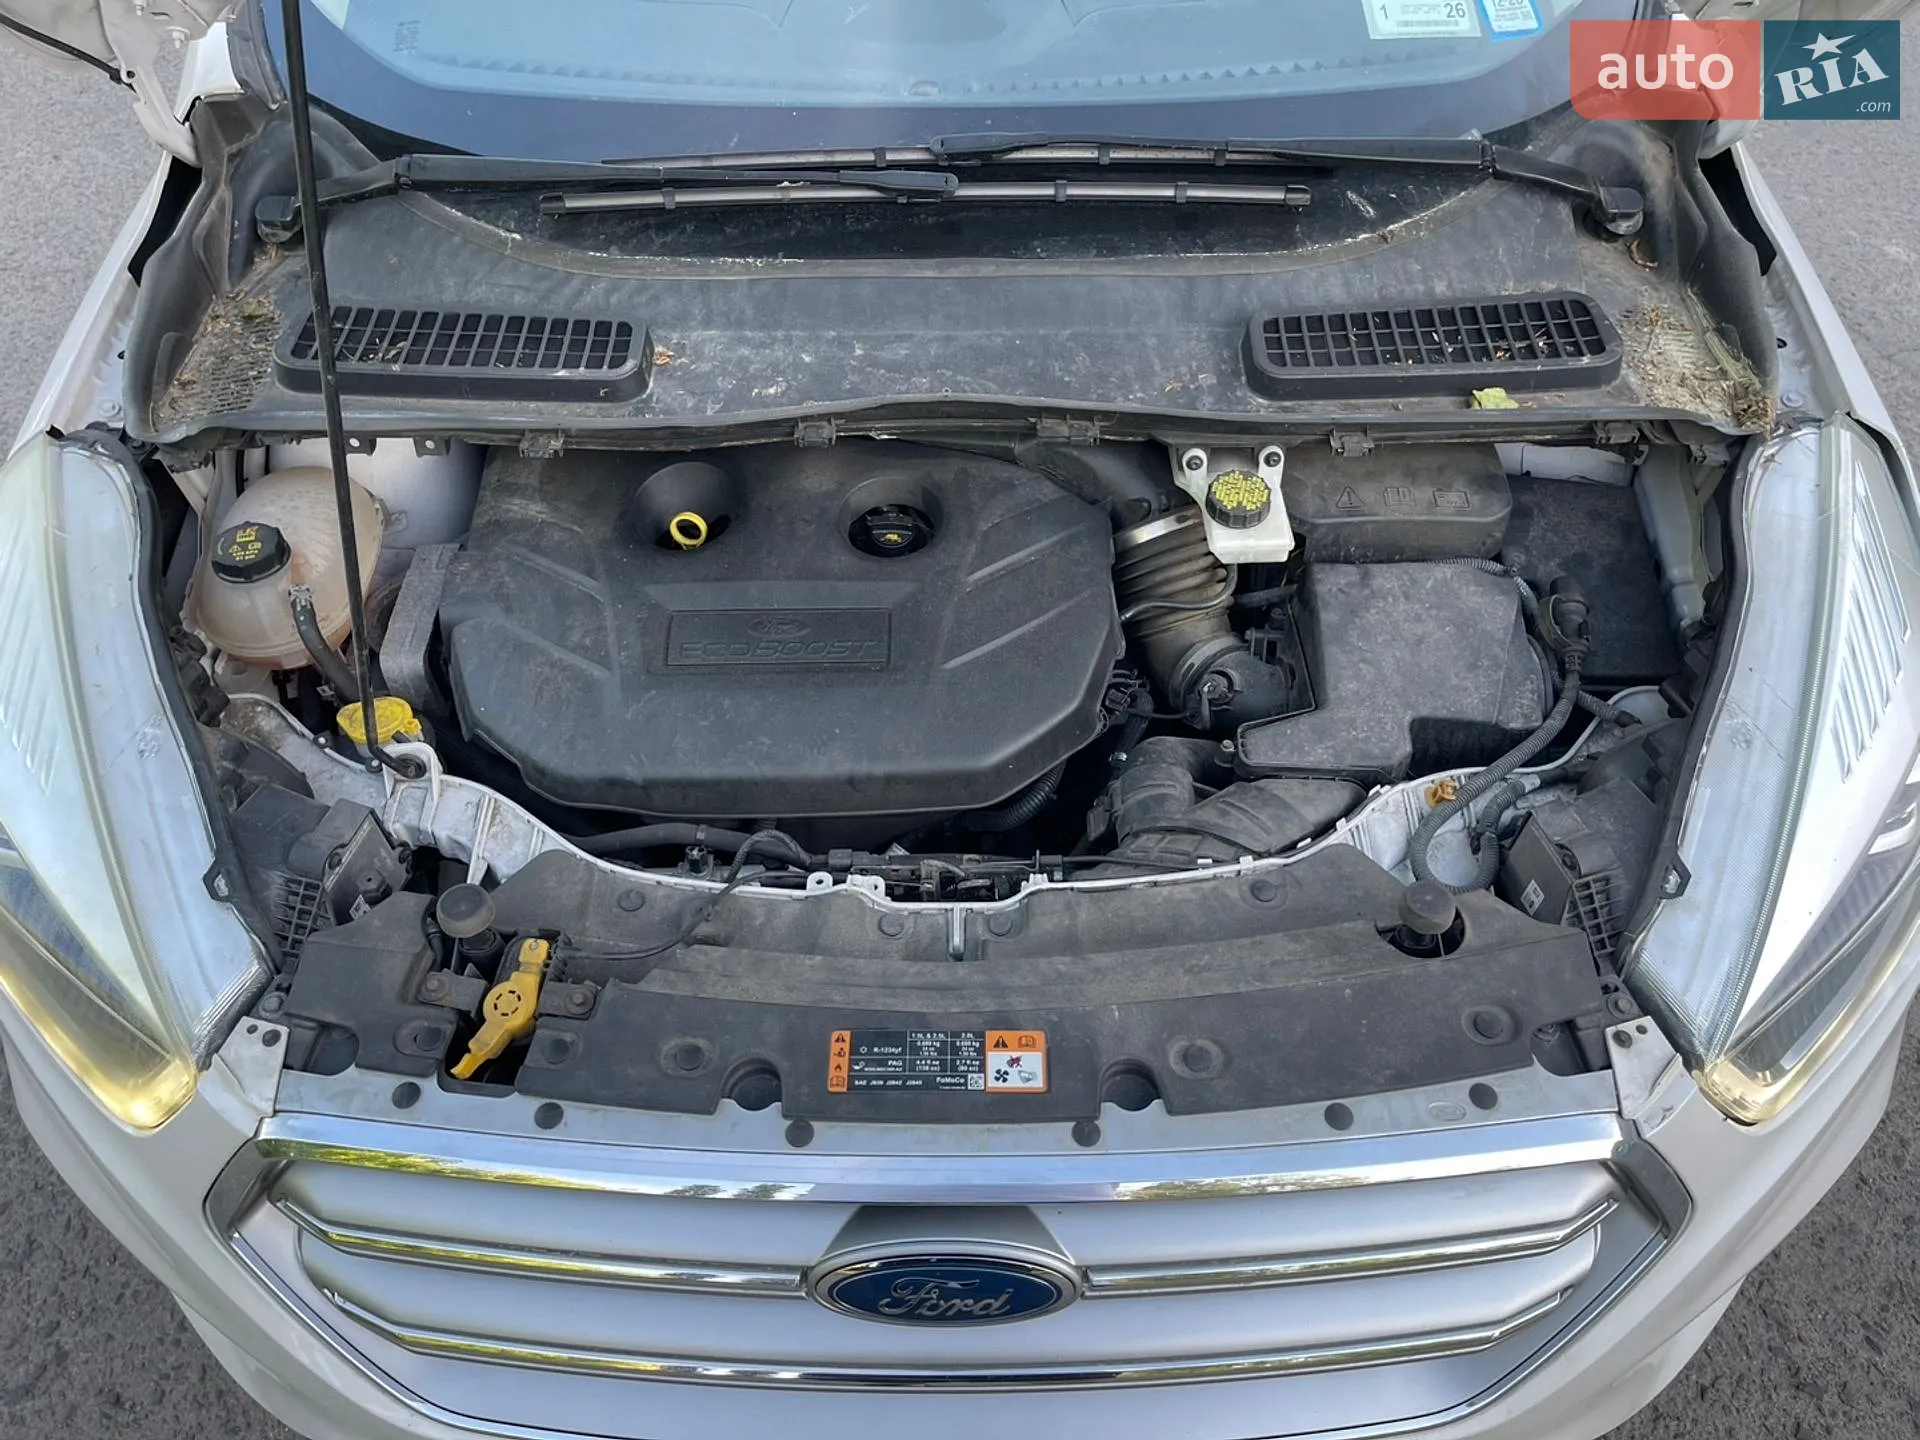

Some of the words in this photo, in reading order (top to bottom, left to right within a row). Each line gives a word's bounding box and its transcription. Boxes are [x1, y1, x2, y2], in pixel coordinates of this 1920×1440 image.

[1379, 4, 1389, 20] 1
[1444, 2, 1466, 19] 26
[936, 1076, 965, 1084] FoMoCo
[879, 1277, 1013, 1316] Ford
